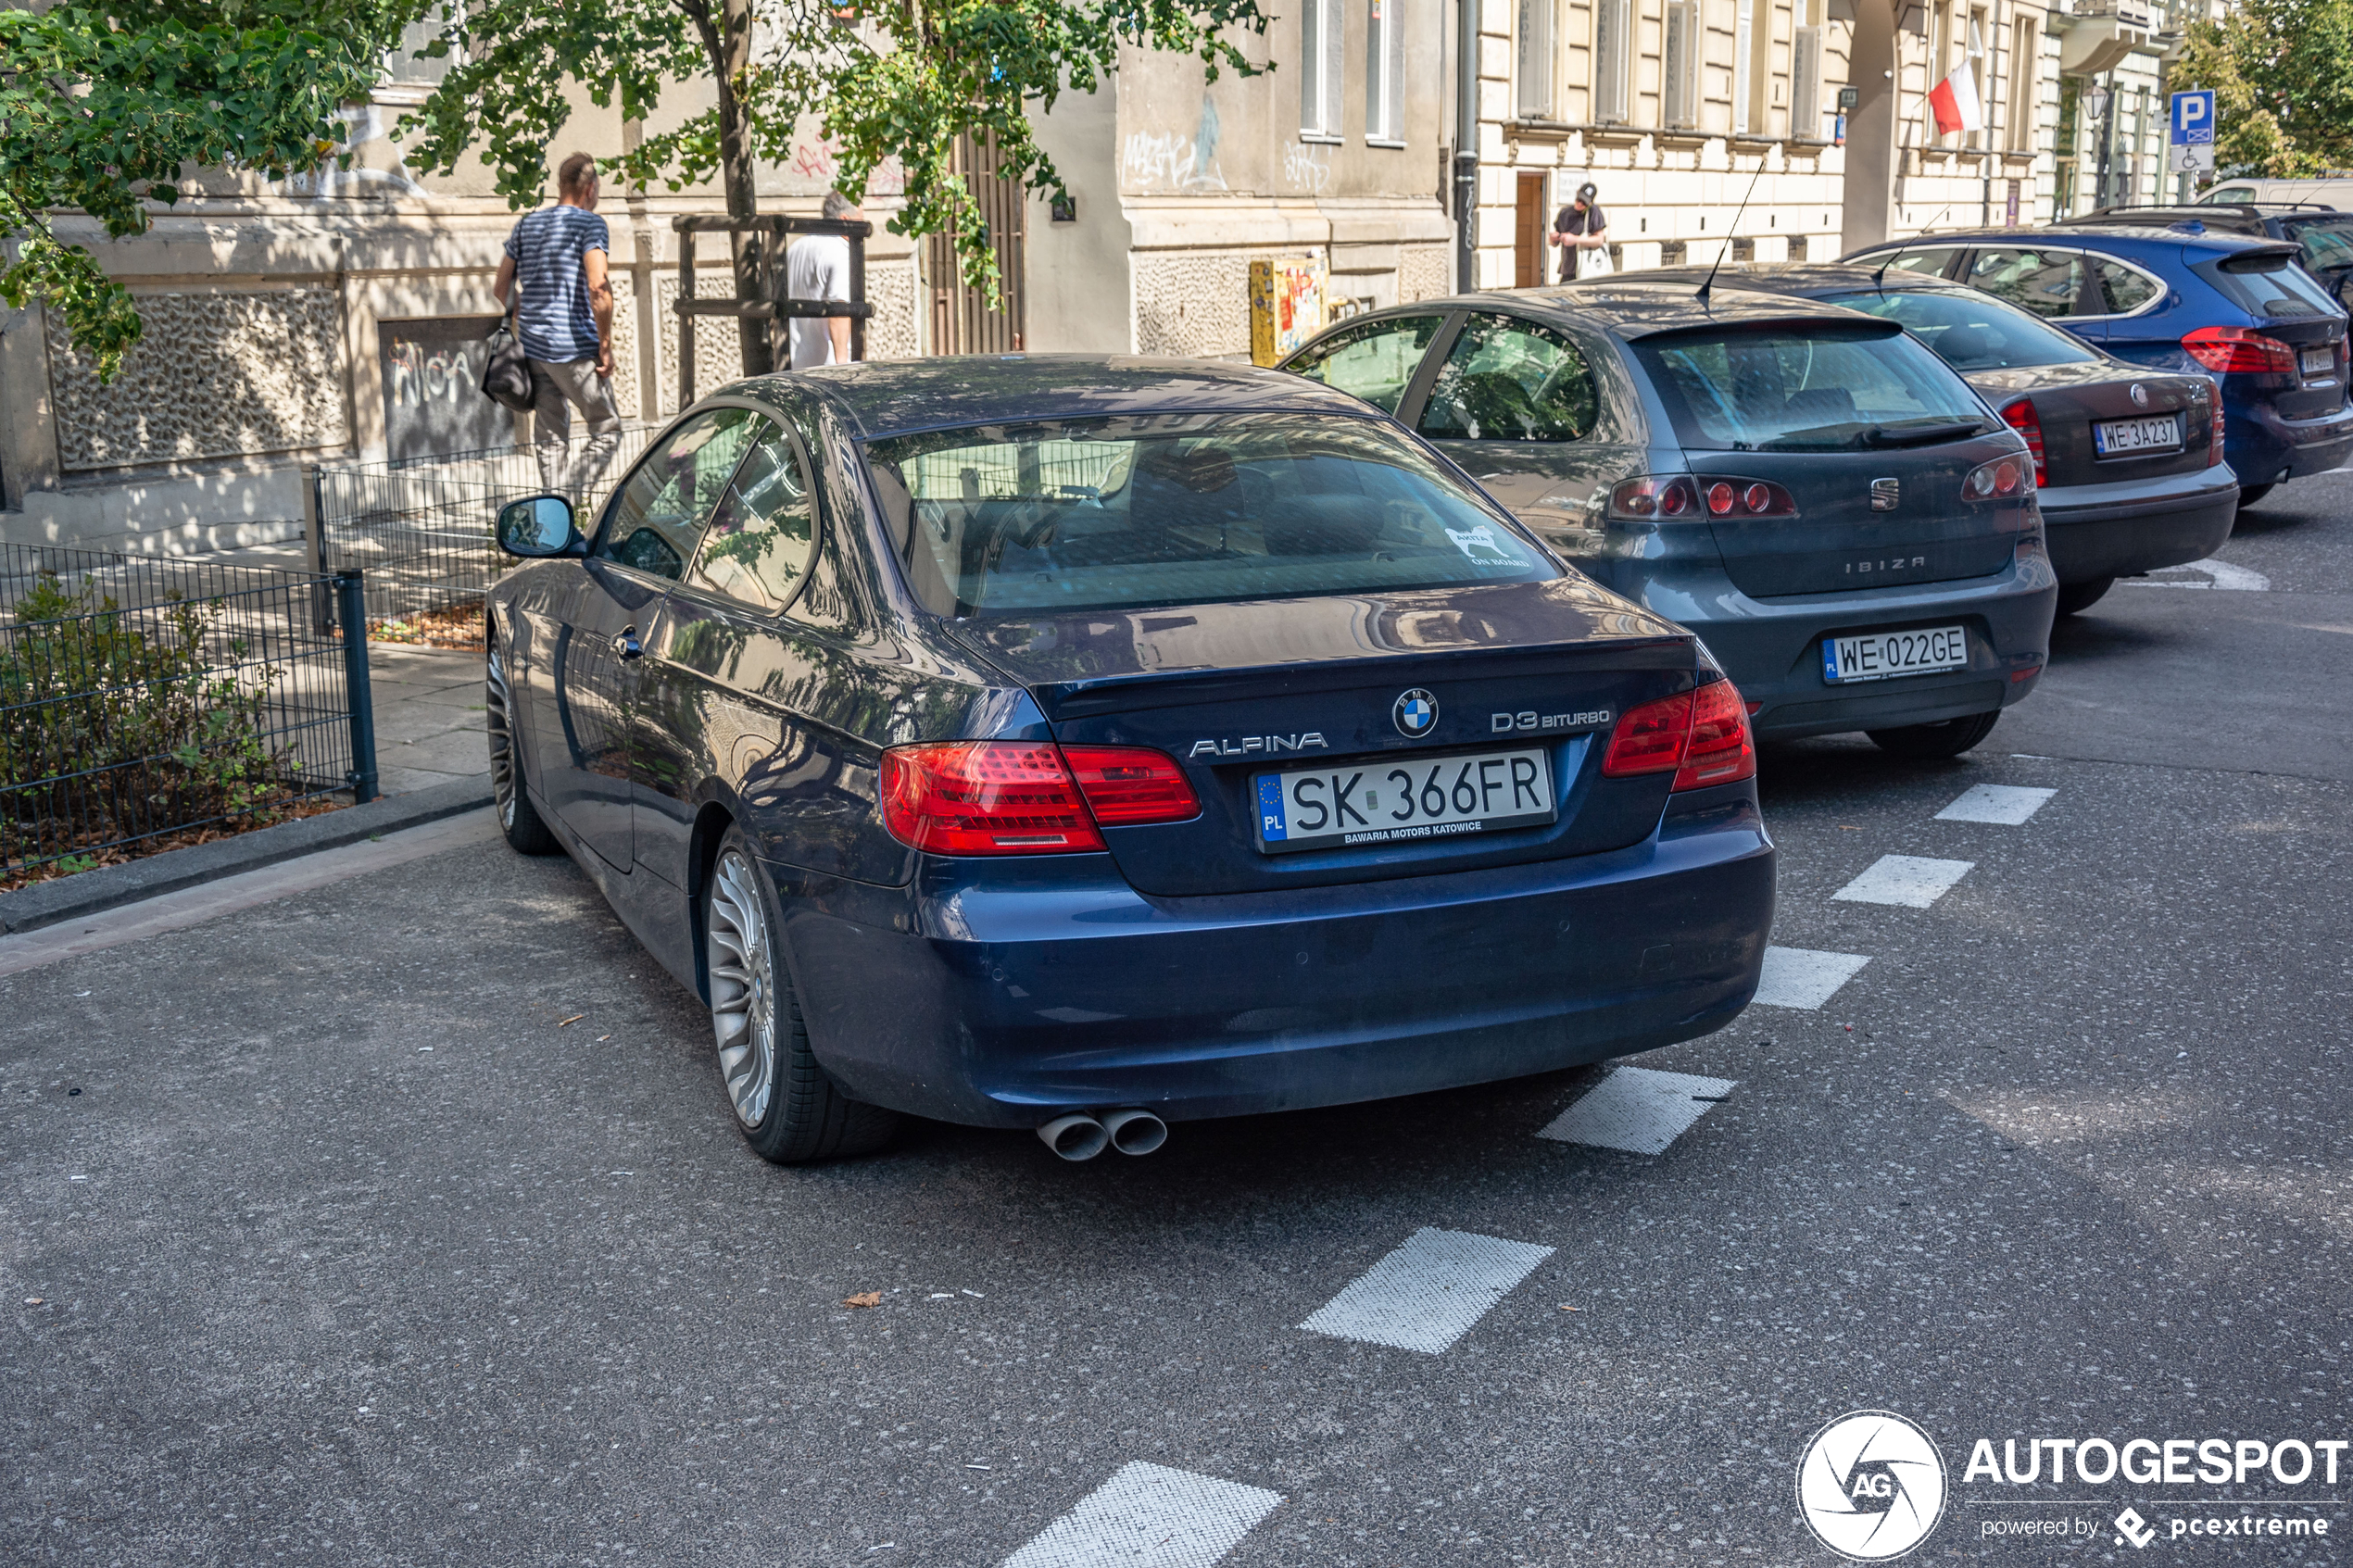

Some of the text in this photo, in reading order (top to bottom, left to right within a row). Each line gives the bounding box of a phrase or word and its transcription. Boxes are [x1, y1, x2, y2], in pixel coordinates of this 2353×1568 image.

[2180, 95, 2205, 131] P
[2105, 424, 2128, 449] WE
[2131, 420, 2173, 445] 3A237
[1471, 558, 1529, 568] ON BOARD
[1845, 557, 1925, 574] IBIZA
[1840, 629, 1964, 673] WE 022GE
[1826, 662, 1837, 672] PL
[1398, 690, 1436, 708] BMW
[1491, 709, 1610, 734] D3 BITURBO
[1189, 731, 1329, 759] ALPINA
[1291, 756, 1541, 831] SK 366FR
[1264, 815, 1283, 832] PL
[1344, 821, 1482, 844] BAWARIA MOTORS KATOWICE
